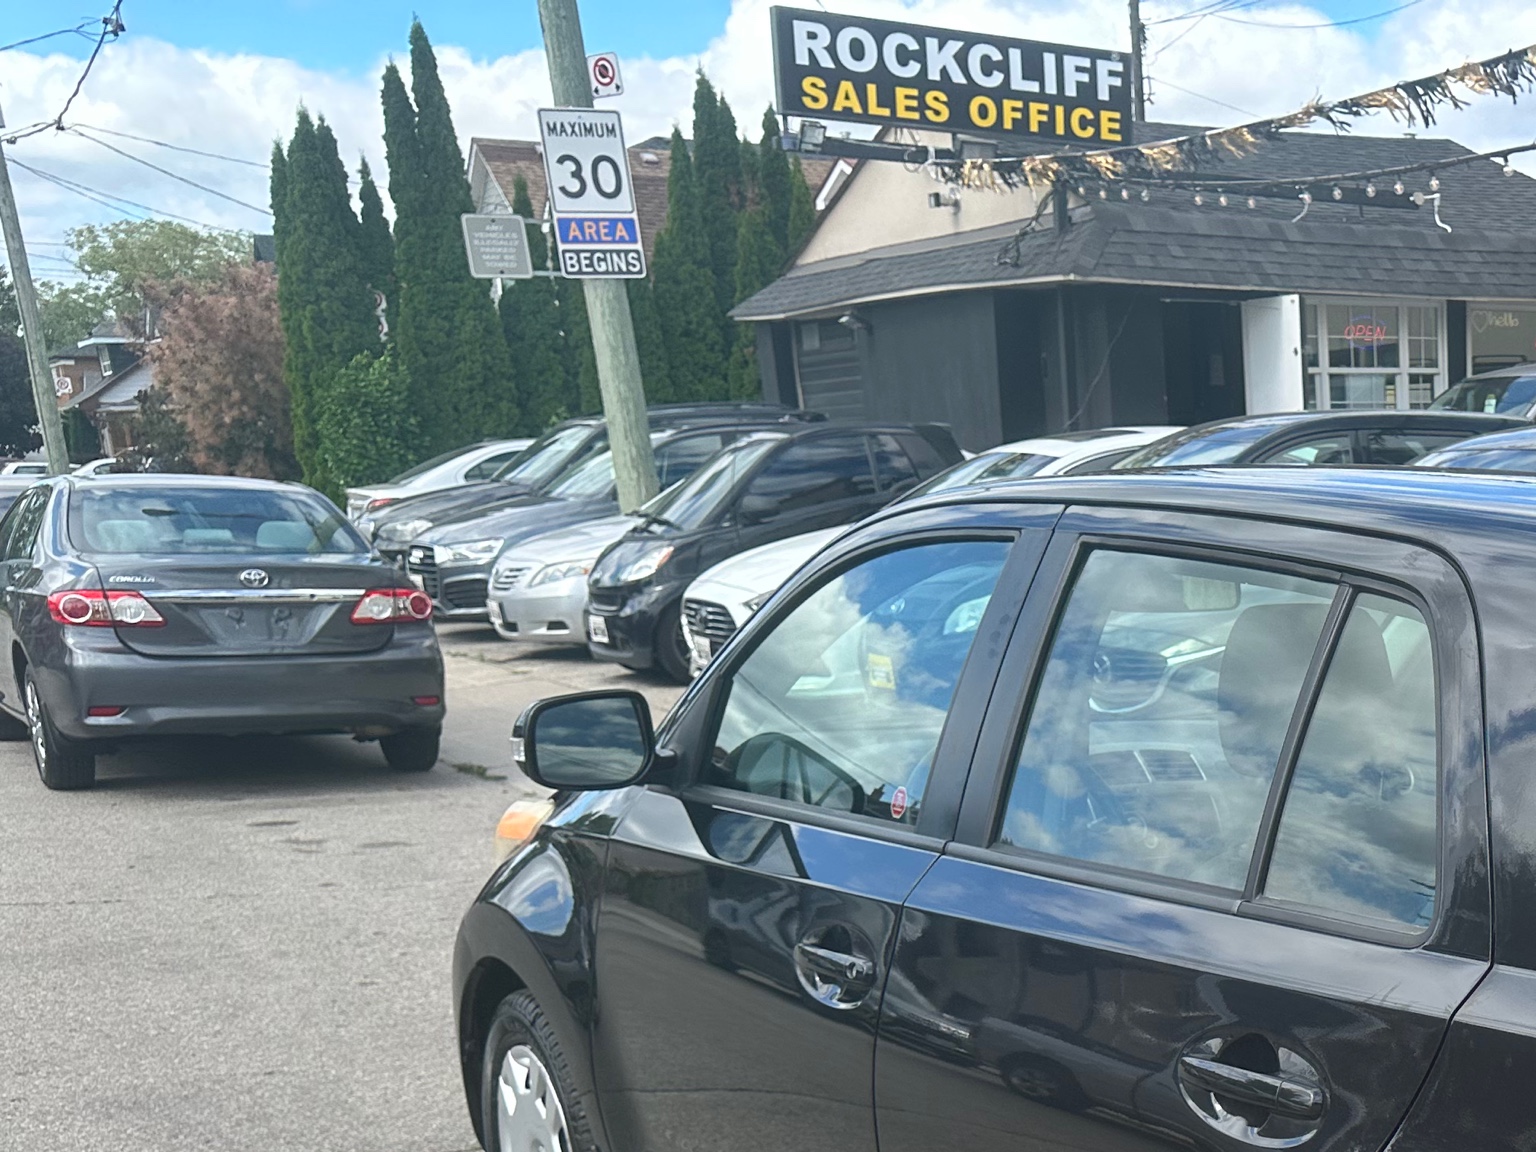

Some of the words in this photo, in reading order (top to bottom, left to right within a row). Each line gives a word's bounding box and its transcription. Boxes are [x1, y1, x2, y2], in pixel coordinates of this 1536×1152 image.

[792, 19, 1124, 101] ROCKCLIFF
[801, 76, 950, 123] SALES
[968, 95, 1123, 142] OFFICE
[546, 121, 617, 138] MAXIMUM
[556, 154, 622, 199] 30
[568, 221, 630, 242] AREA
[564, 252, 641, 273] BEGINS
[1344, 324, 1387, 341] OPEN
[108, 575, 155, 583] COROLLA
